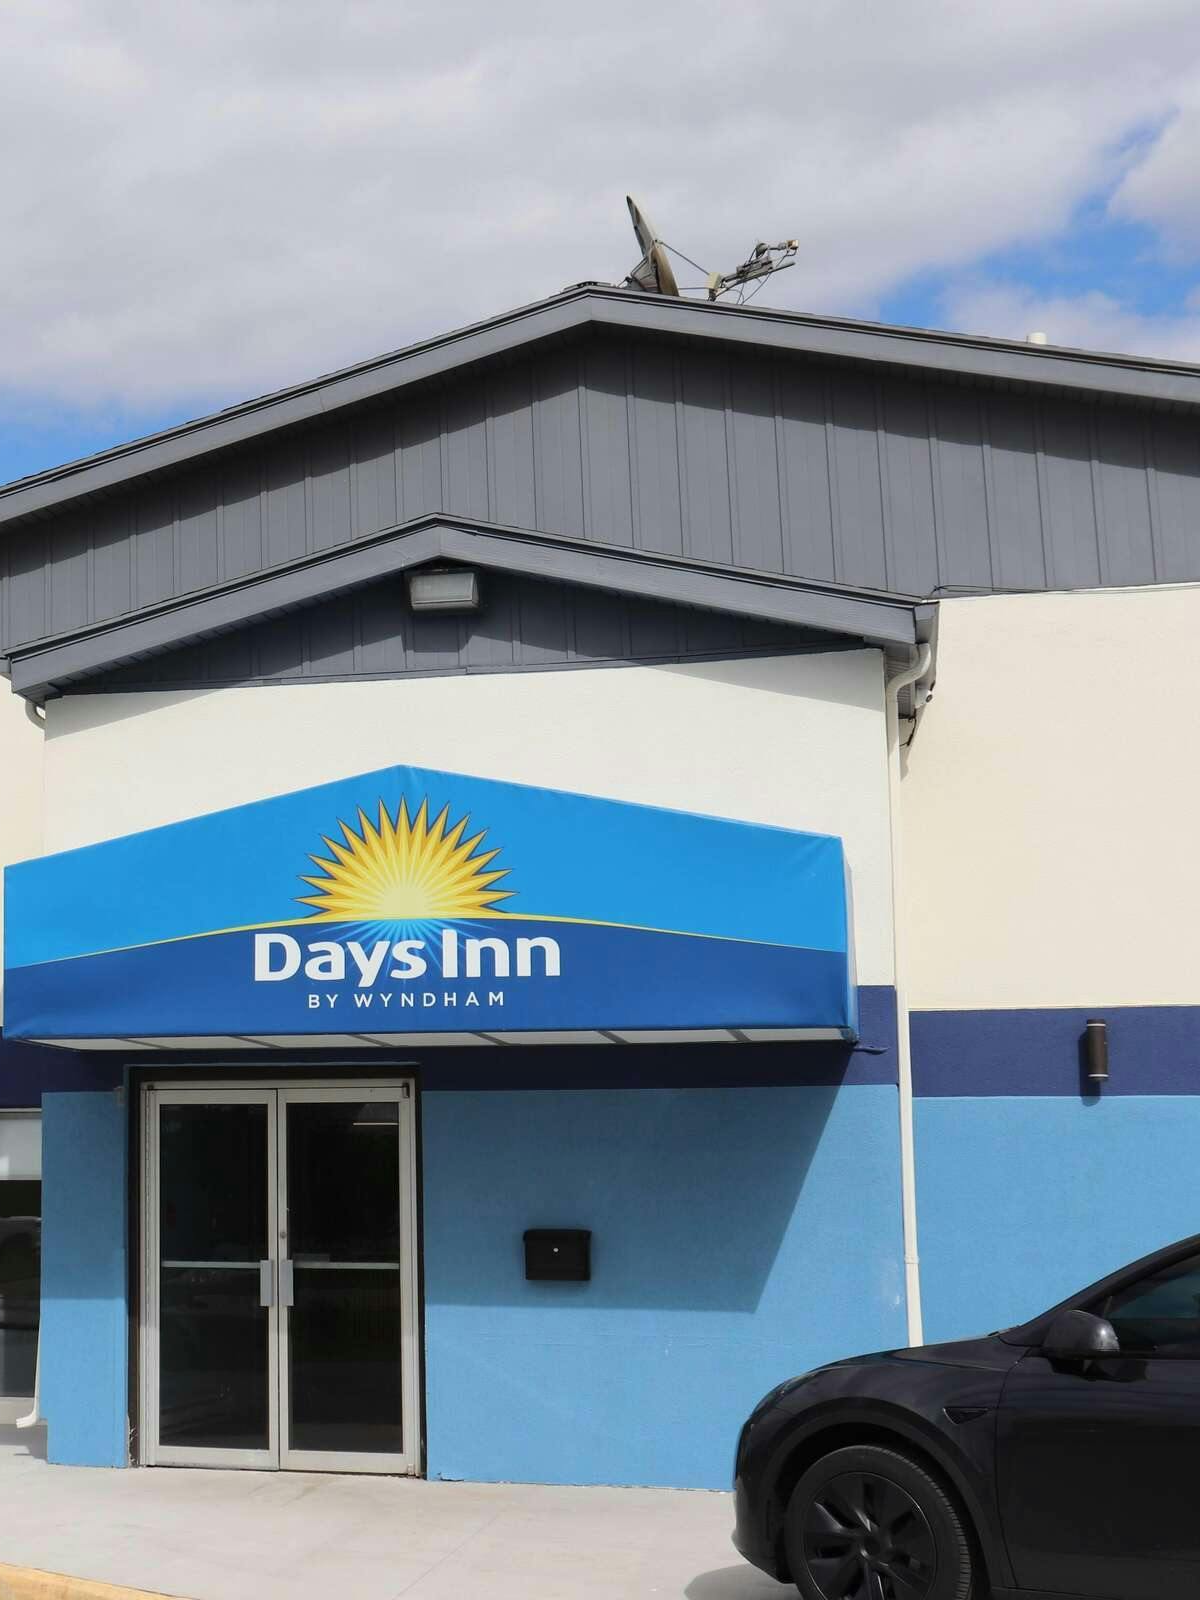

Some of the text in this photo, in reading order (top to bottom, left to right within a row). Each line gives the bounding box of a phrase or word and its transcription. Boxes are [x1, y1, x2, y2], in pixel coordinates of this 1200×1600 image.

[254, 929, 560, 987] Days Inn
[308, 991, 504, 1009] BY WYNDHAM
